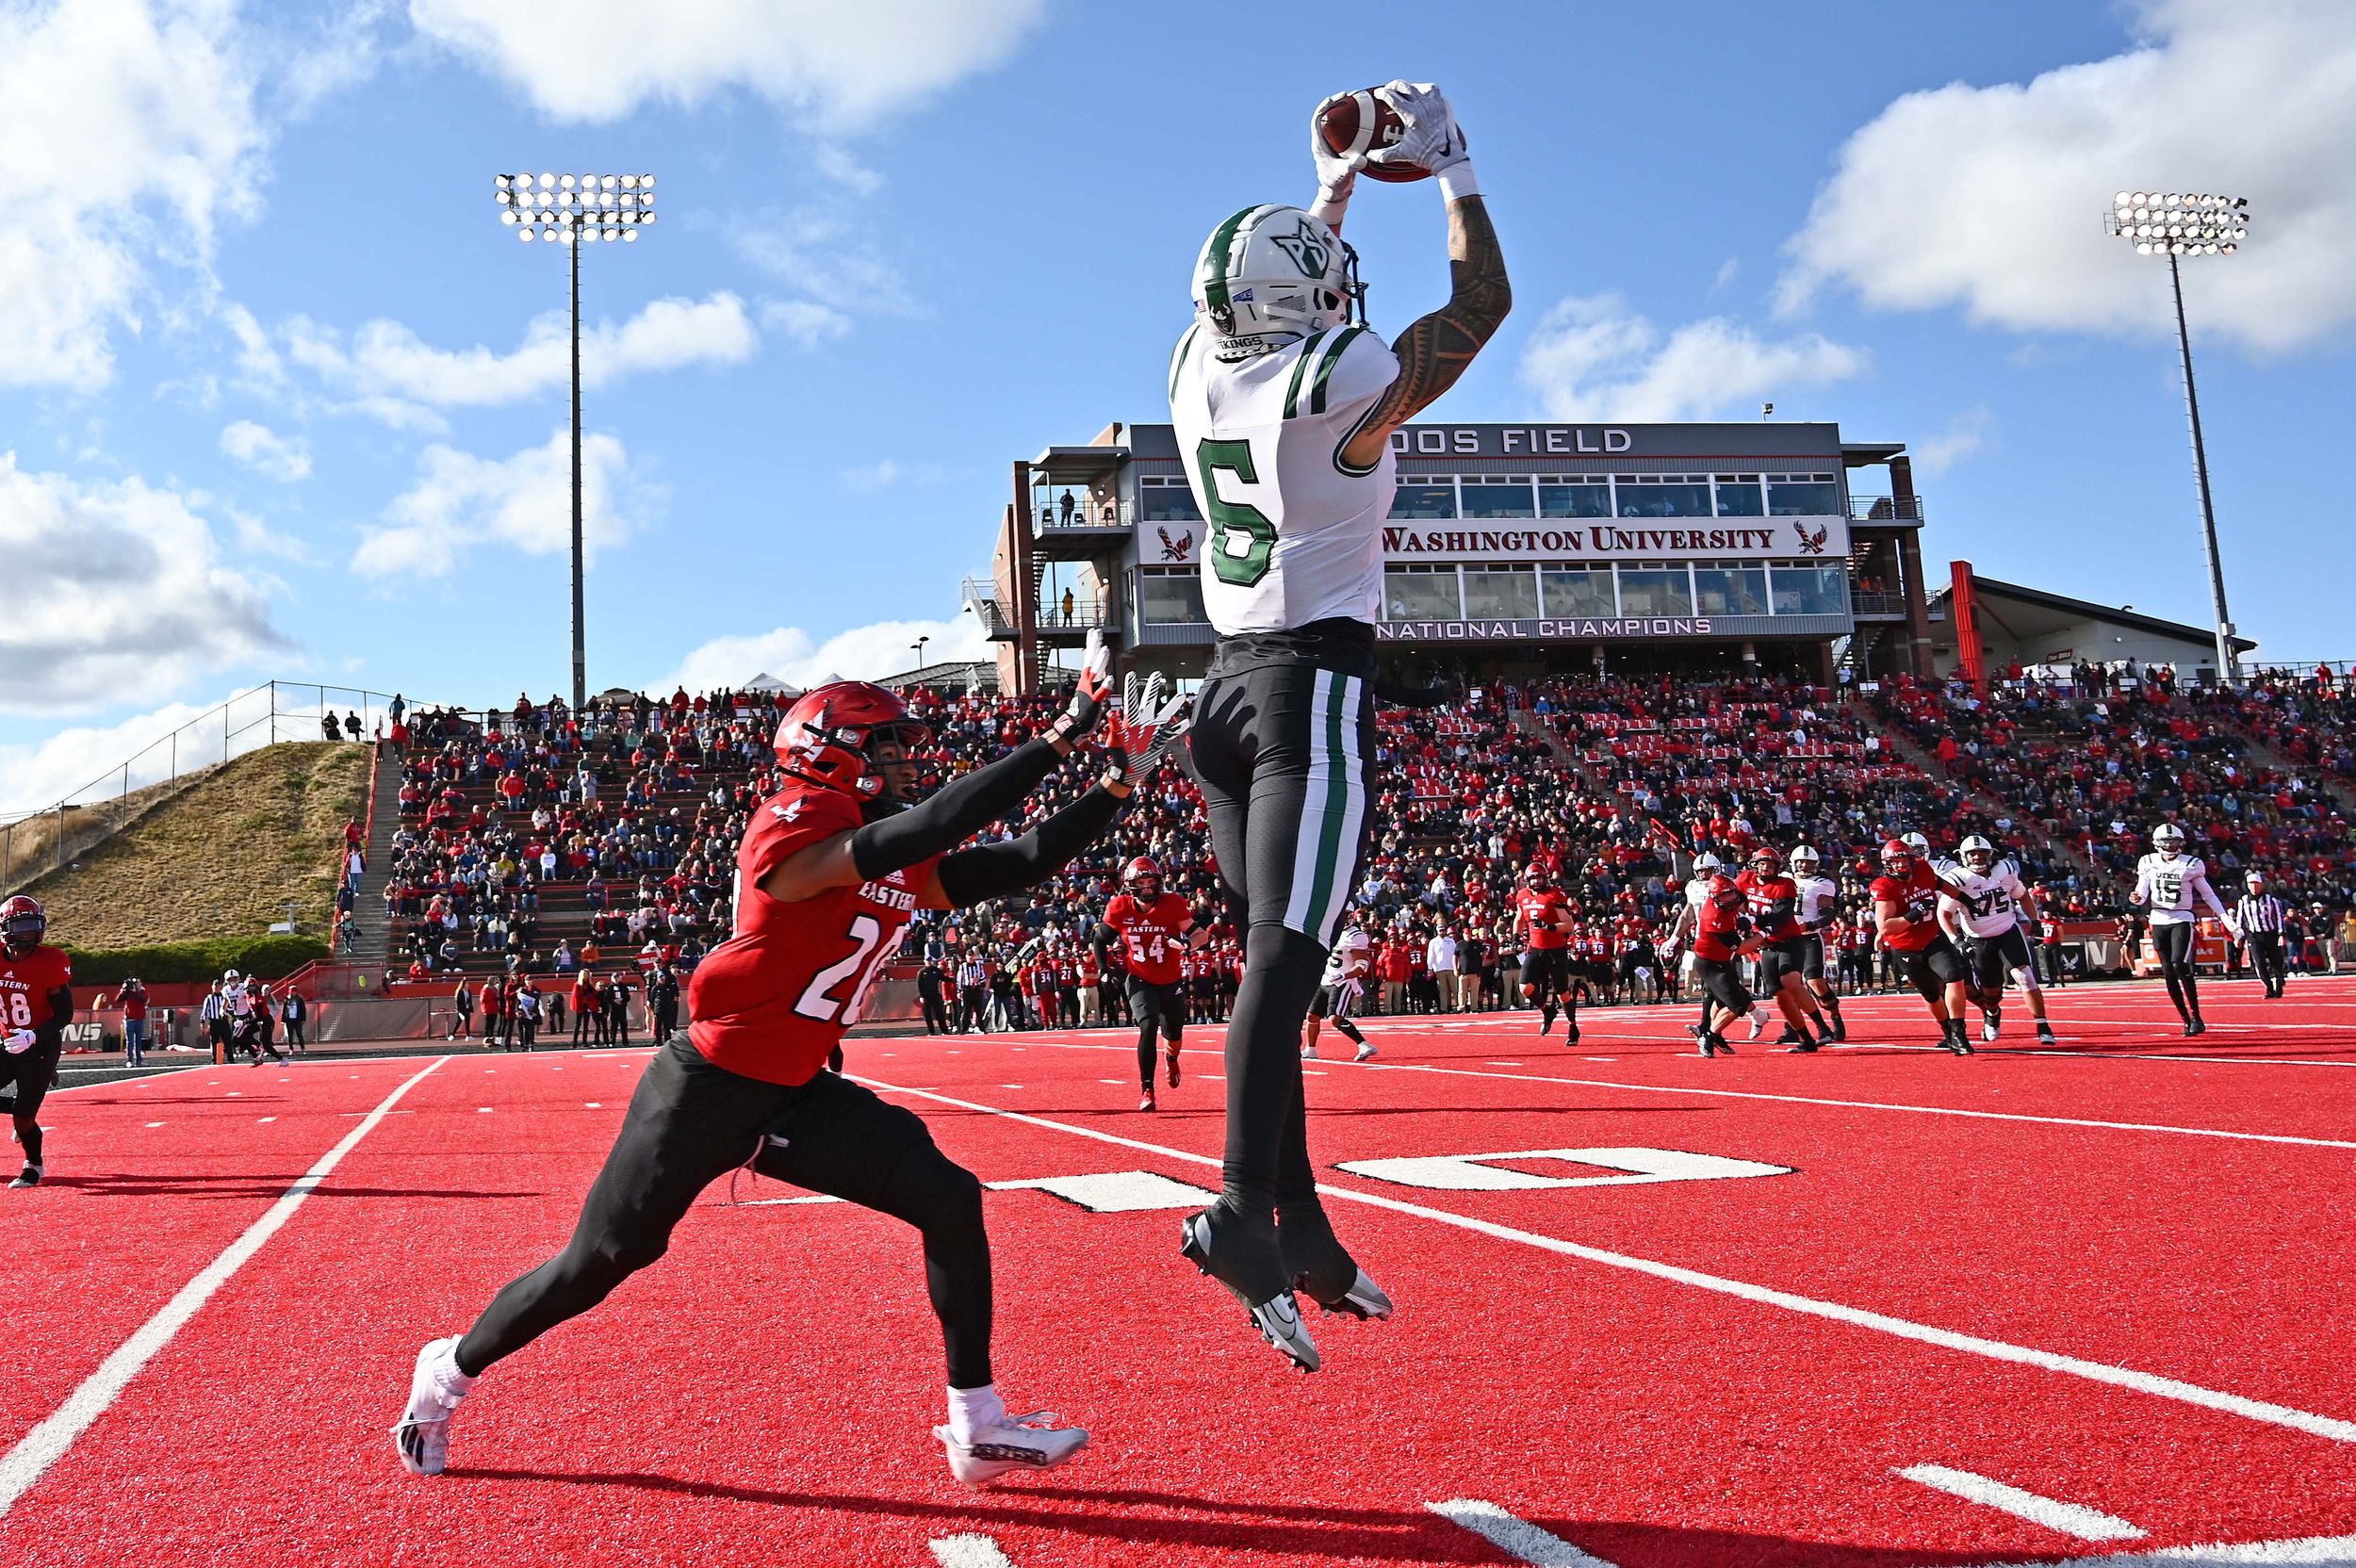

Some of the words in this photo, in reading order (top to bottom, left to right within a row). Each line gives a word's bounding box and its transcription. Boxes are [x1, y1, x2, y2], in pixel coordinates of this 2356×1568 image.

[1502, 429, 1631, 452] FIELD
[1383, 527, 1582, 552] WASHINGTON
[1589, 526, 1775, 551] UNIVERSITY
[1376, 622, 1527, 639] NATIONAL
[1538, 618, 1711, 637] CHAMPIONS
[2155, 880, 2182, 904] 15
[1127, 925, 1167, 934] EASTERN
[1127, 934, 1166, 964] 54
[1060, 970, 1072, 980] 21
[1199, 964, 1206, 974] 2
